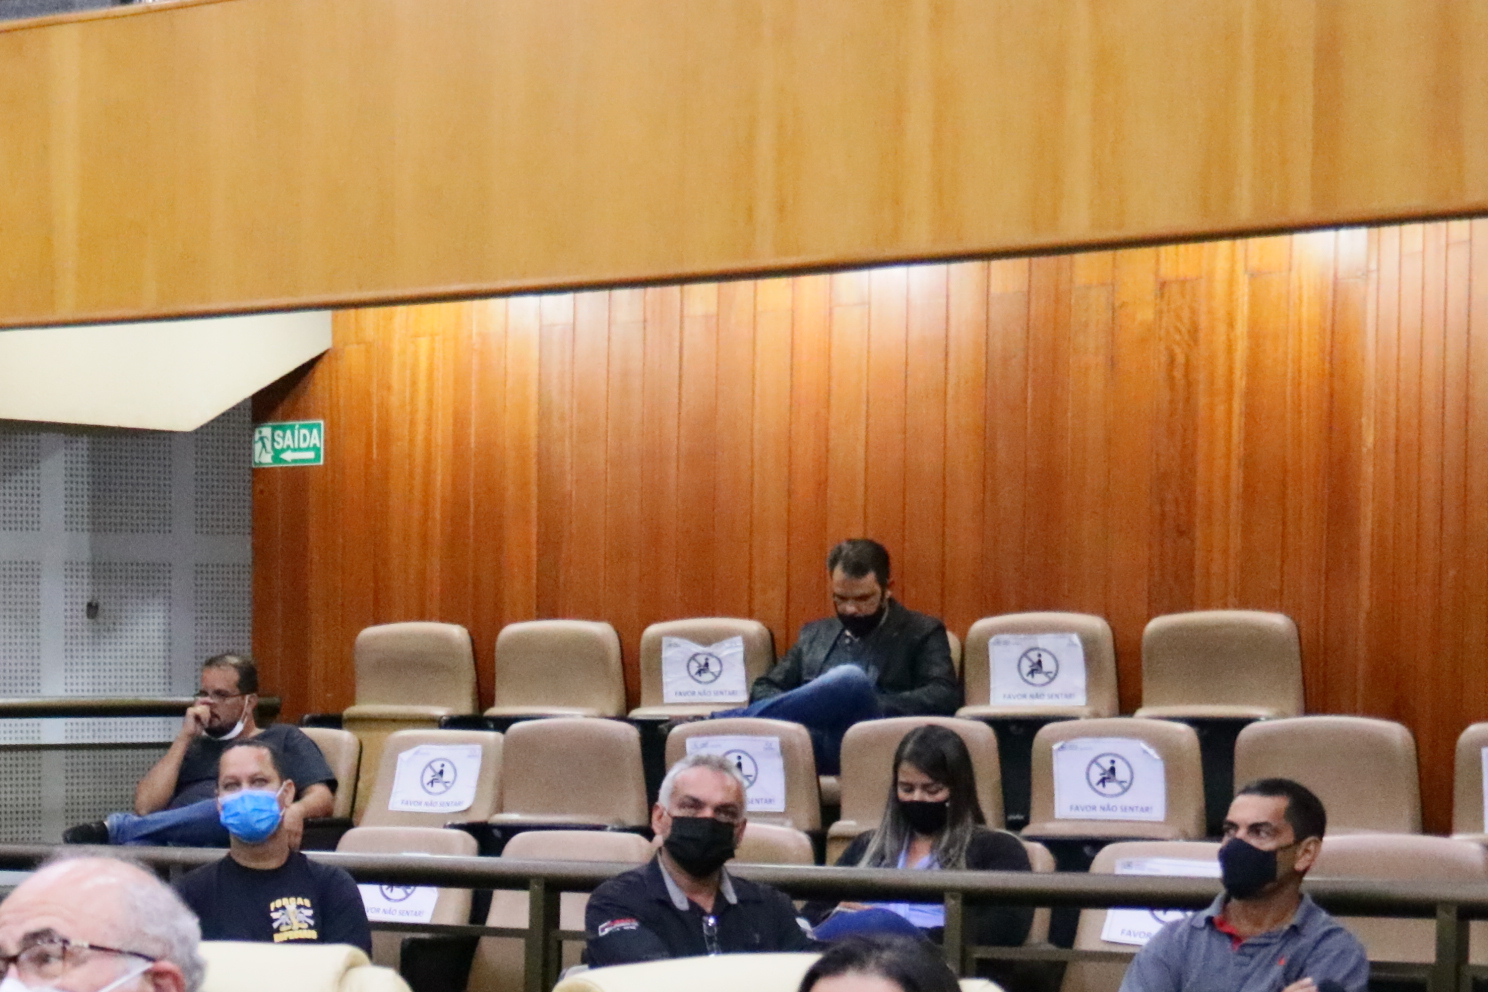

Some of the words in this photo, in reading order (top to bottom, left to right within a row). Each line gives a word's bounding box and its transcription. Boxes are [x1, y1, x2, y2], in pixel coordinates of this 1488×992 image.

[273, 425, 320, 449] SAÍDA
[1069, 804, 1097, 813] FAVOR
[1099, 803, 1118, 813] NÃO
[1120, 805, 1153, 814] SENTAR!
